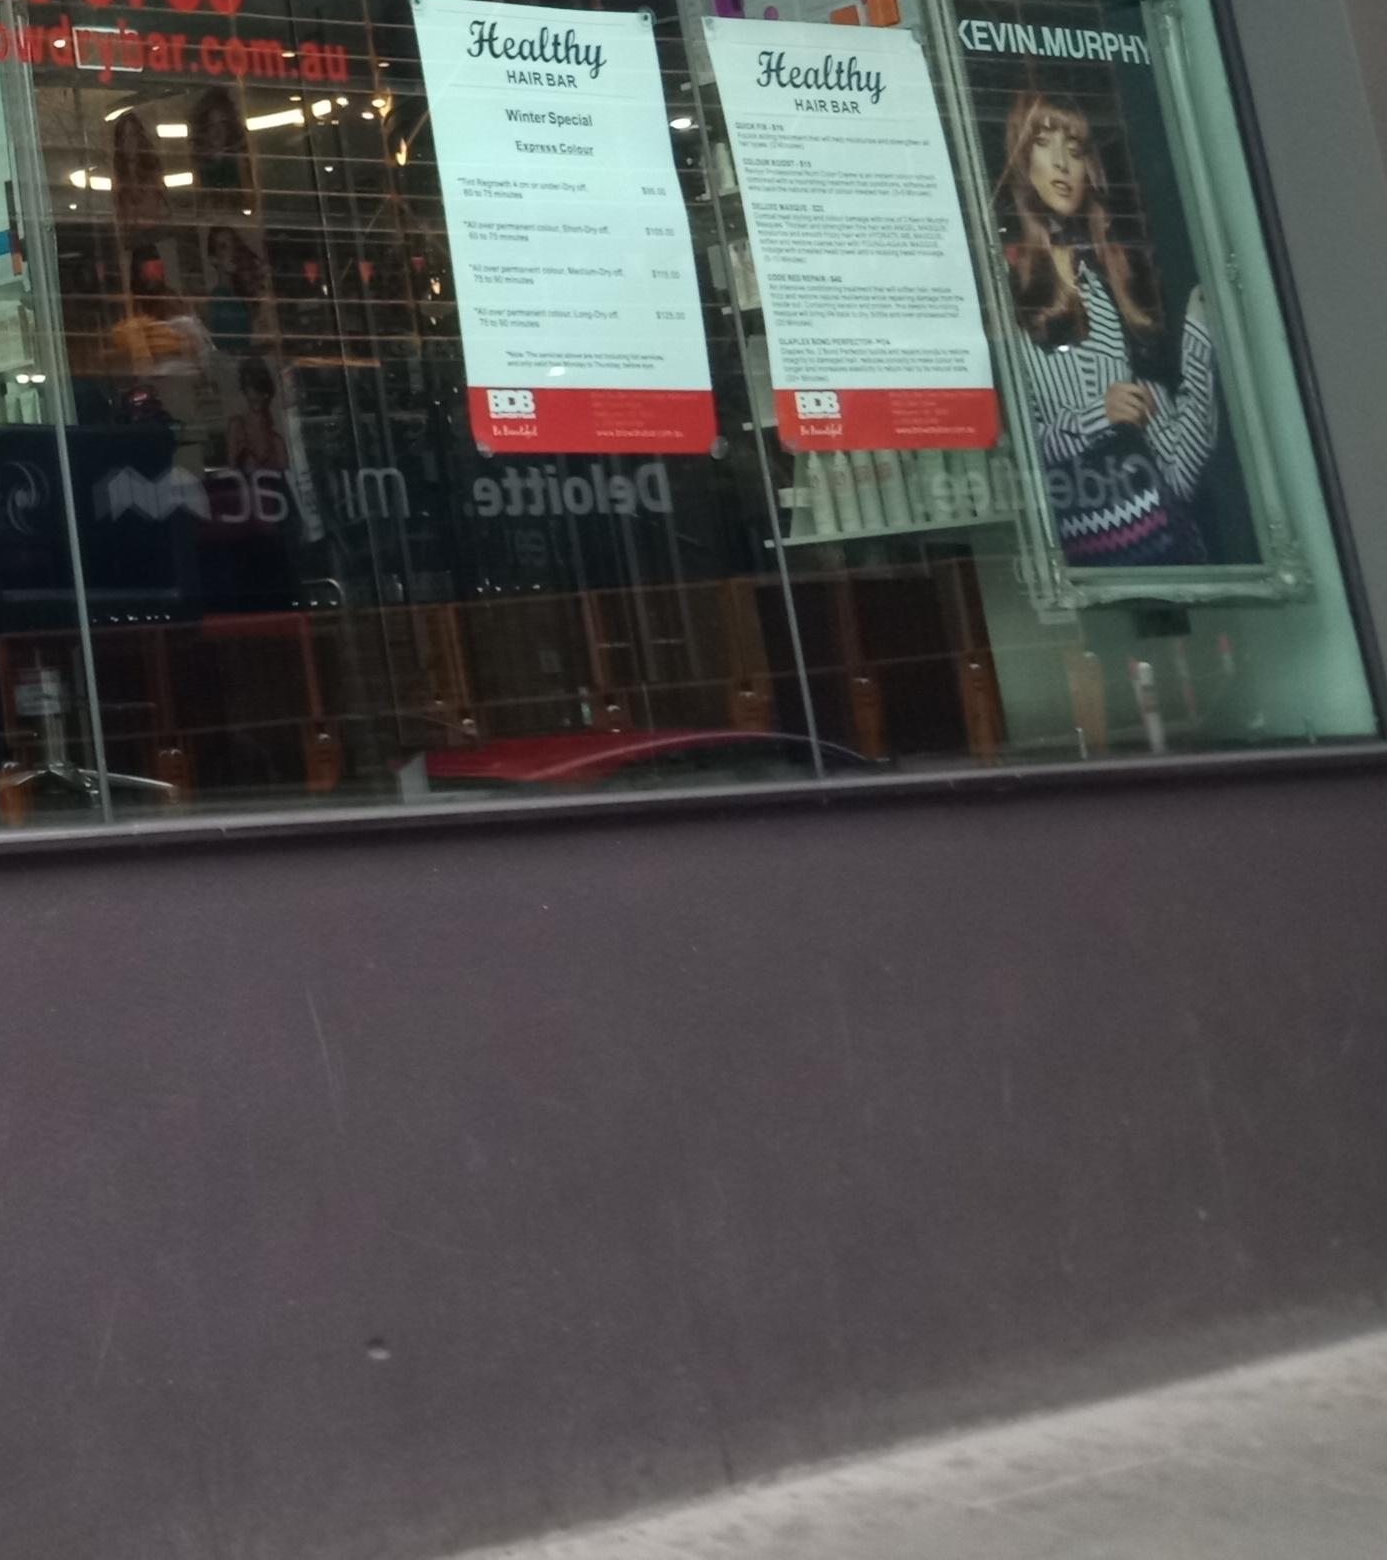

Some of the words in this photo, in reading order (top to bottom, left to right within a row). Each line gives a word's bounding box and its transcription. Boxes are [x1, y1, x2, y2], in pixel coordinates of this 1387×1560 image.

[467, 20, 607, 79] Healthy
[506, 70, 543, 86] HAIR
[546, 72, 578, 88] BAR
[756, 51, 886, 104] Healthy
[794, 99, 829, 113] HAIR
[831, 100, 861, 114] BAR
[505, 109, 546, 124] Winter
[548, 111, 593, 128] Special
[515, 140, 558, 154] Express
[560, 143, 594, 155] Colour
